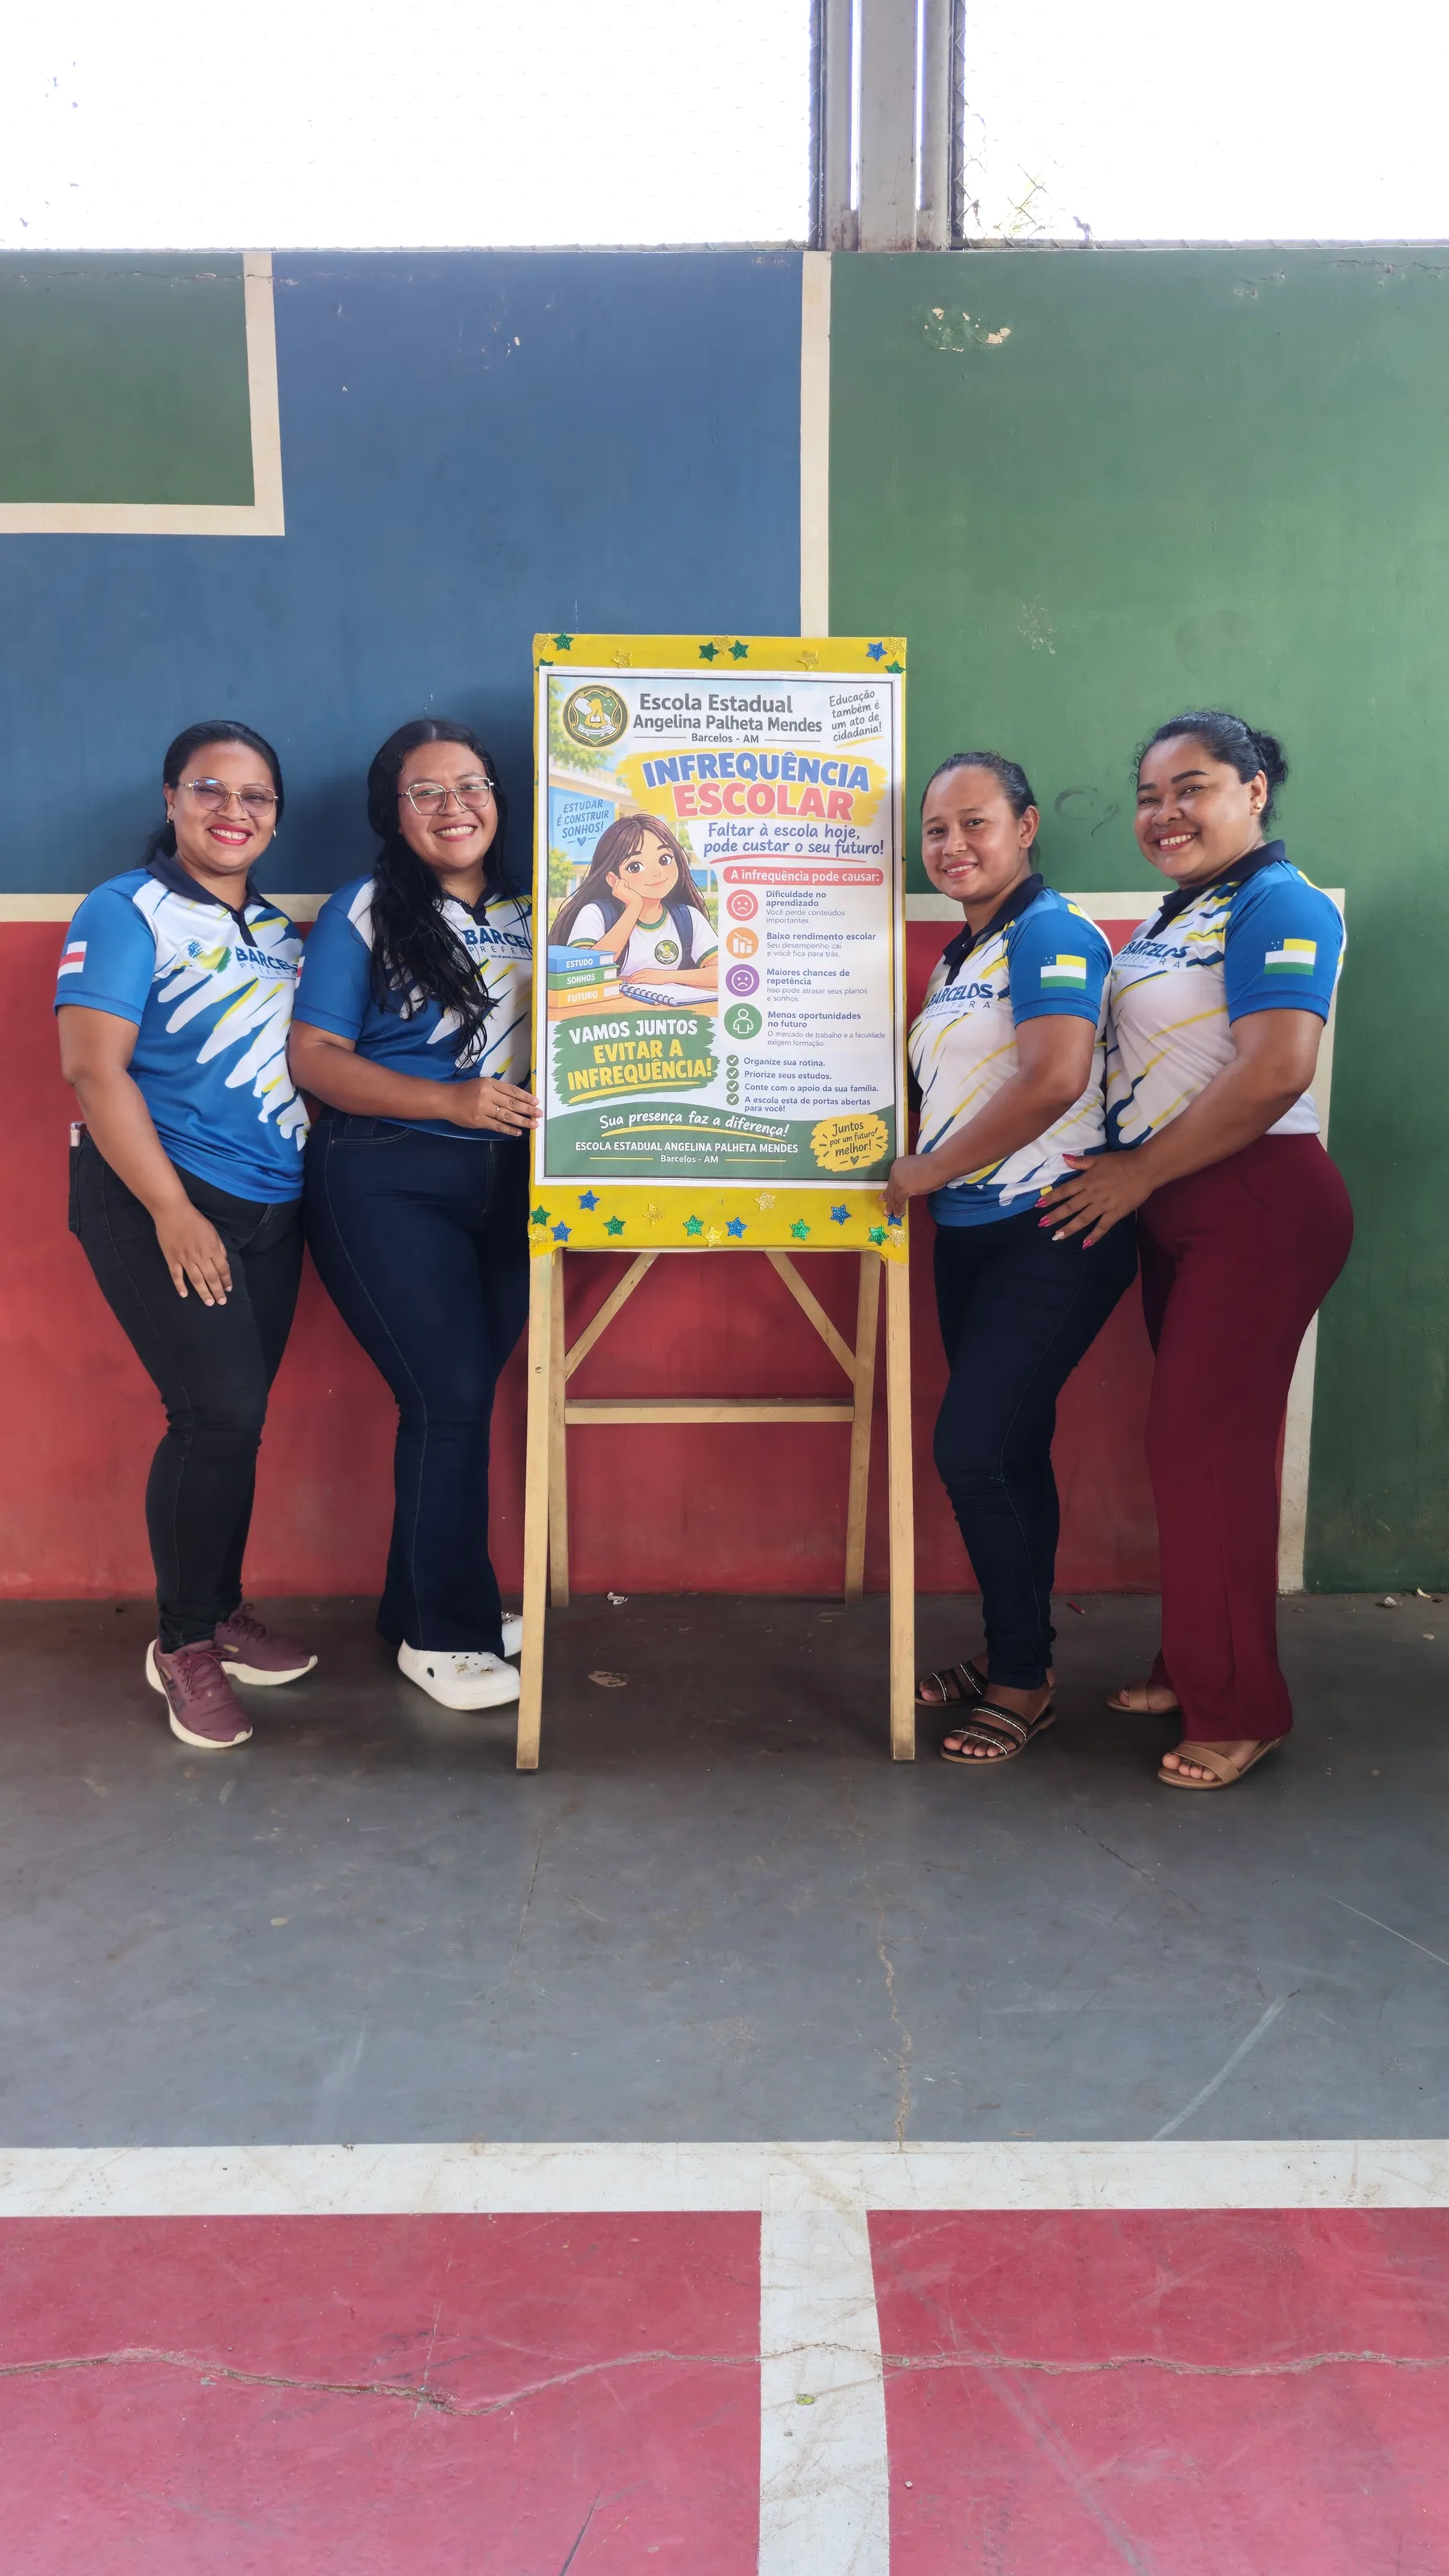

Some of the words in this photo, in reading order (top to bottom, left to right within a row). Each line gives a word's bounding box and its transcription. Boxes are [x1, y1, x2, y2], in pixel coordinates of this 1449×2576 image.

[640, 693, 701, 711] Escola
[708, 694, 793, 713] Estadual
[829, 690, 875, 707] Educação
[832, 703, 871, 718] também
[875, 700, 879, 709] é
[633, 715, 701, 732] Angelina
[706, 715, 763, 730] Palheta
[768, 717, 822, 732] Mendes
[832, 722, 845, 730] um
[850, 716, 865, 726] ato
[869, 713, 879, 722] de
[691, 734, 733, 742] Barcelos
[743, 735, 759, 743] AM
[833, 722, 881, 742] cidadania!
[642, 751, 869, 792] INFREQUÊNCIA
[564, 799, 603, 813] ESTUDAR
[673, 782, 852, 821] ESCOLAR
[557, 815, 562, 826] É
[564, 810, 609, 825] CONSTRUIR
[562, 821, 604, 838] SONHOS!
[708, 822, 754, 837] Faltar
[760, 824, 768, 837] à
[774, 824, 818, 837] escola
[825, 825, 860, 843] hoje,
[704, 839, 737, 857] pode
[743, 839, 790, 851] custar
[795, 843, 803, 852] o
[808, 842, 830, 853] seu
[836, 840, 884, 857] futuro!
[731, 870, 738, 879] A
[742, 870, 809, 885] infrequência
[812, 871, 839, 883] pode
[842, 873, 879, 882] causar:
[766, 899, 819, 908] aprendizado
[463, 928, 532, 950] BARCEL
[469, 946, 524, 955] PREFEI
[235, 946, 298, 972] BARCEL
[566, 958, 592, 968] ESTUDO
[567, 974, 595, 985] SONHOS
[767, 978, 811, 986] repetência
[568, 990, 598, 1003] FUTURO
[799, 1011, 861, 1019] oportunidades
[569, 1021, 630, 1044] VAMOS
[635, 1019, 698, 1036] JUNTOS
[593, 1041, 663, 1064] EVITAR
[669, 1040, 683, 1056] A
[744, 1058, 781, 1067] Organize
[567, 1058, 712, 1090] INFREQUÊNCIA!
[798, 1085, 819, 1093] apoio
[753, 1096, 778, 1104] escola
[813, 1098, 838, 1106] portas
[600, 1115, 623, 1128] Sua
[629, 1112, 683, 1127] presença
[688, 1110, 708, 1124] faz
[713, 1118, 720, 1126] a
[725, 1118, 790, 1137] diferença!
[832, 1122, 864, 1136] Juntos
[576, 1142, 611, 1151] ESCOLA
[614, 1142, 662, 1151] ESTADUAL
[664, 1142, 712, 1152] ANGELINA
[715, 1143, 757, 1152] PALHETA
[759, 1144, 798, 1152] MENDES
[830, 1138, 840, 1147] por
[855, 1131, 874, 1141] futuro
[836, 1139, 872, 1157] melhor!
[661, 1155, 696, 1163] Barcelos
[704, 1156, 718, 1164] AM
